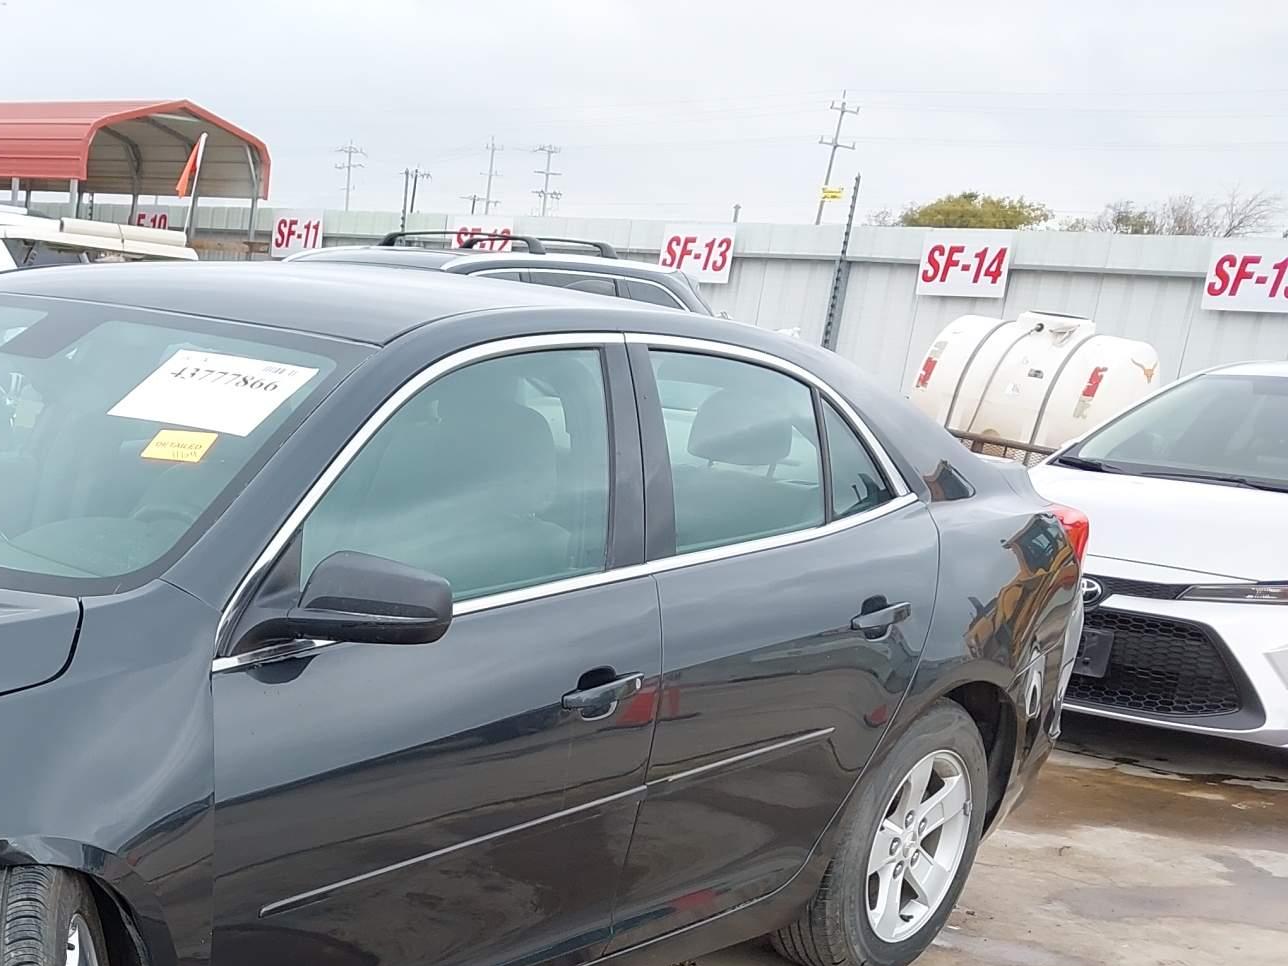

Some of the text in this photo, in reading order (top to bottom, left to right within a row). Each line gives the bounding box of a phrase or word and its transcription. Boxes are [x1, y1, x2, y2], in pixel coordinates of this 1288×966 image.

[274, 218, 321, 249] SF-11
[661, 235, 732, 272] SF-13
[921, 244, 1008, 284] SF-14
[1207, 254, 1288, 298] SF-1
[169, 366, 279, 392] 43777866
